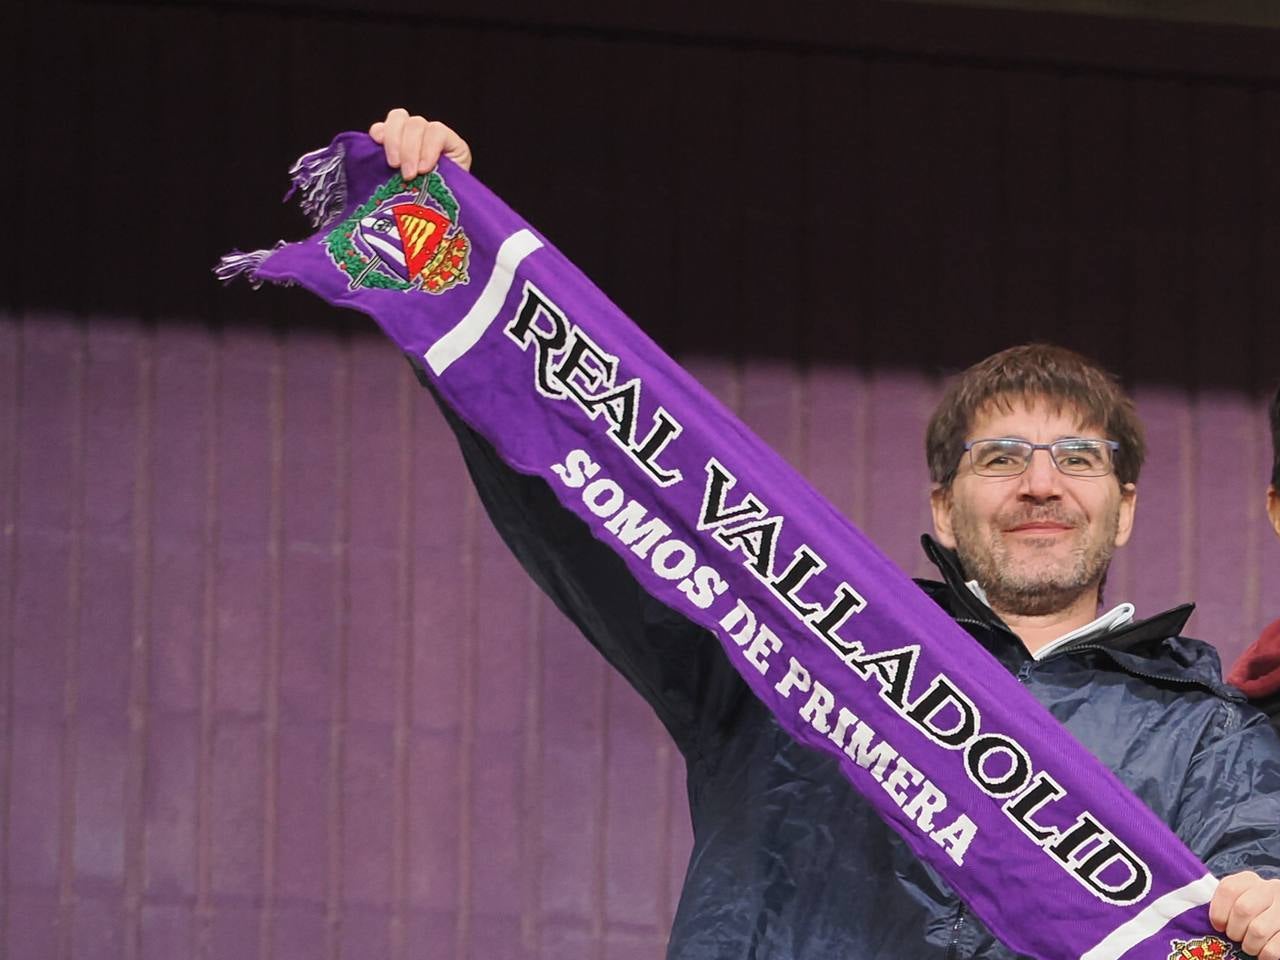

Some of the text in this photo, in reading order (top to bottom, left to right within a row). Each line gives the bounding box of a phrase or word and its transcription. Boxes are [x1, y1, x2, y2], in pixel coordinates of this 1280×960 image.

[503, 280, 1153, 906] REAL VALLADOLID
[550, 449, 981, 868] SOMOS DE PRIMERA
